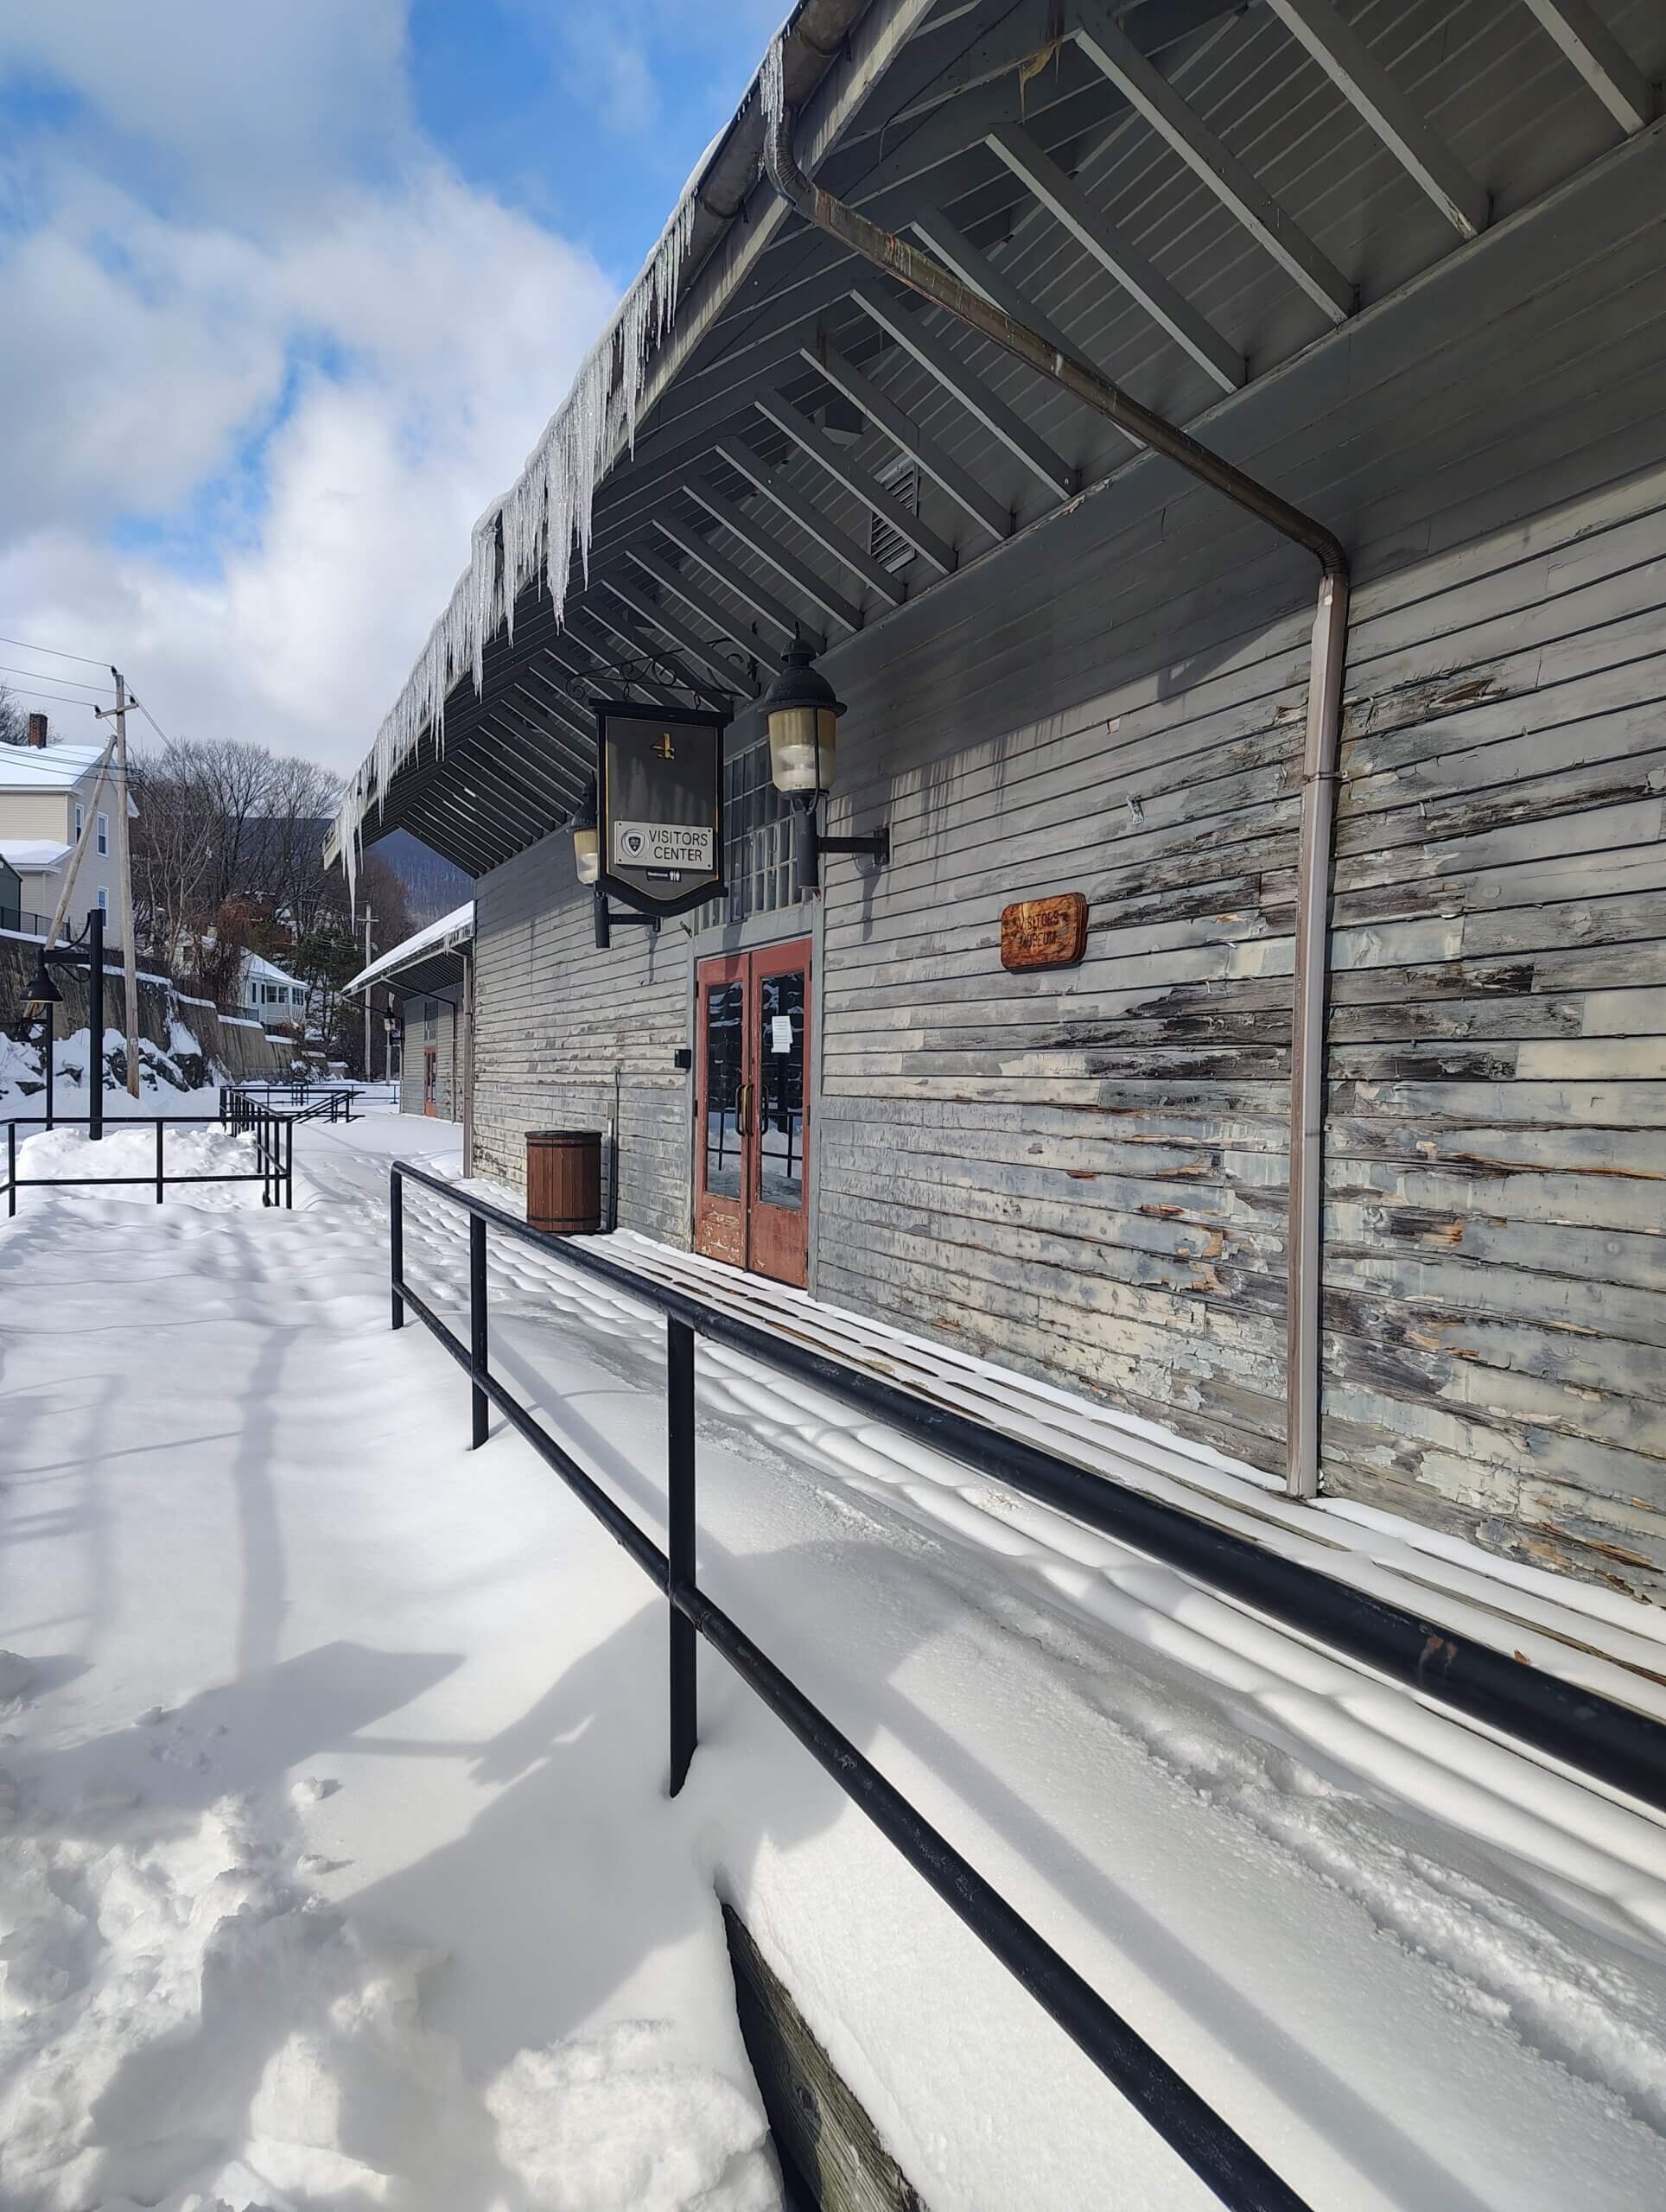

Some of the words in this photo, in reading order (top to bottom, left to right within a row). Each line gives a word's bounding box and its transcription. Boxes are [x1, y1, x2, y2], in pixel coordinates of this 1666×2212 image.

[650, 733, 676, 760] 4
[649, 830, 709, 847] VISITORS
[653, 846, 703, 861] CENTER
